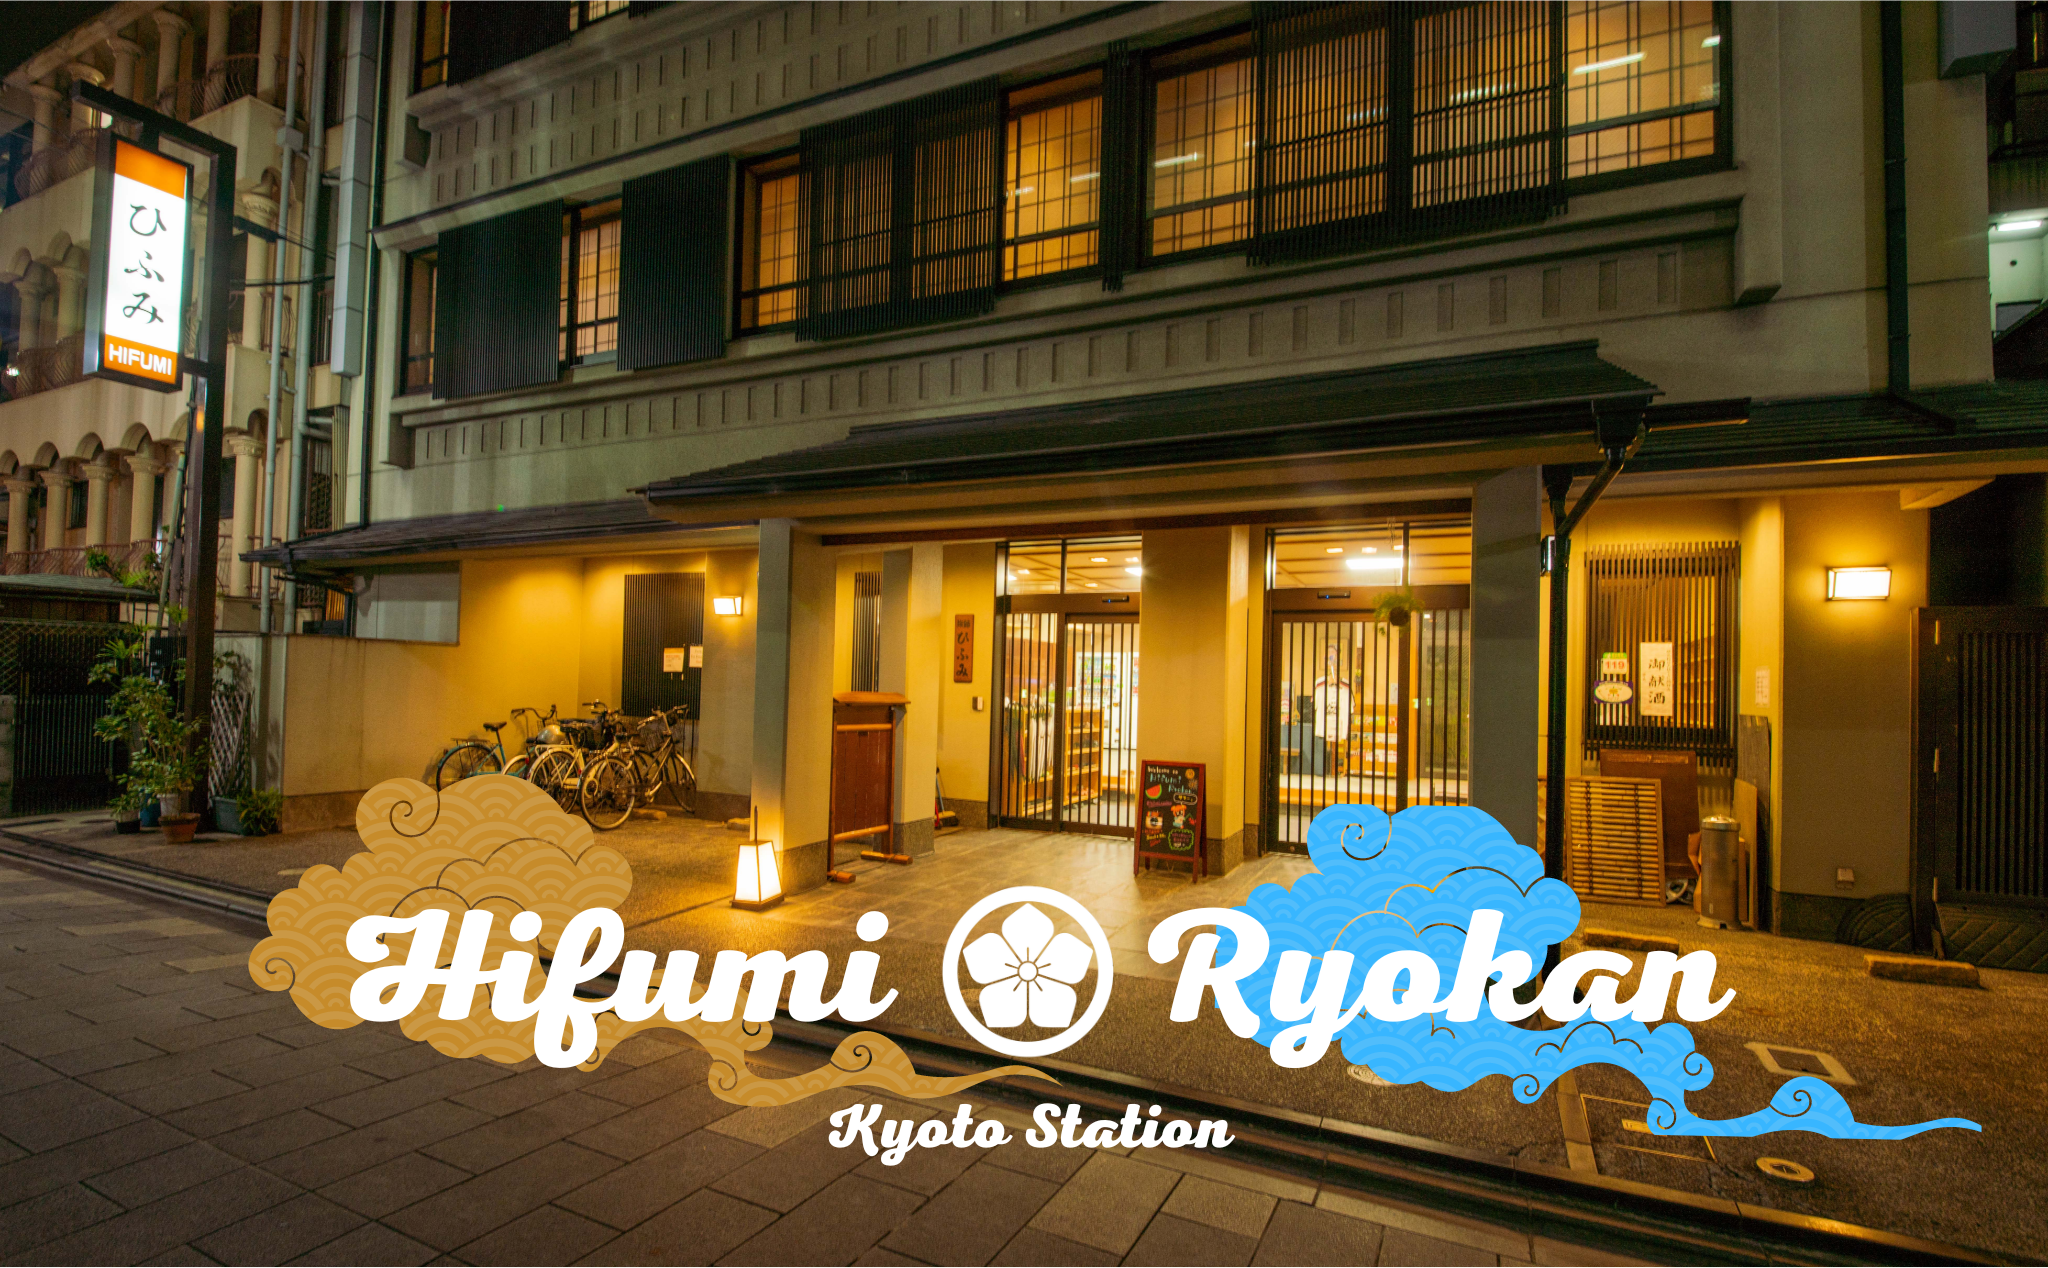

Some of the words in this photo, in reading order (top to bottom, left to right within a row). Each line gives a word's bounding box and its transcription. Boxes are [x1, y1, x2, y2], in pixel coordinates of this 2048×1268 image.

[122, 202, 167, 325] ひふみ
[108, 342, 173, 376] HIFUMI
[955, 631, 970, 678] ひふみ
[1605, 660, 1625, 670] 119
